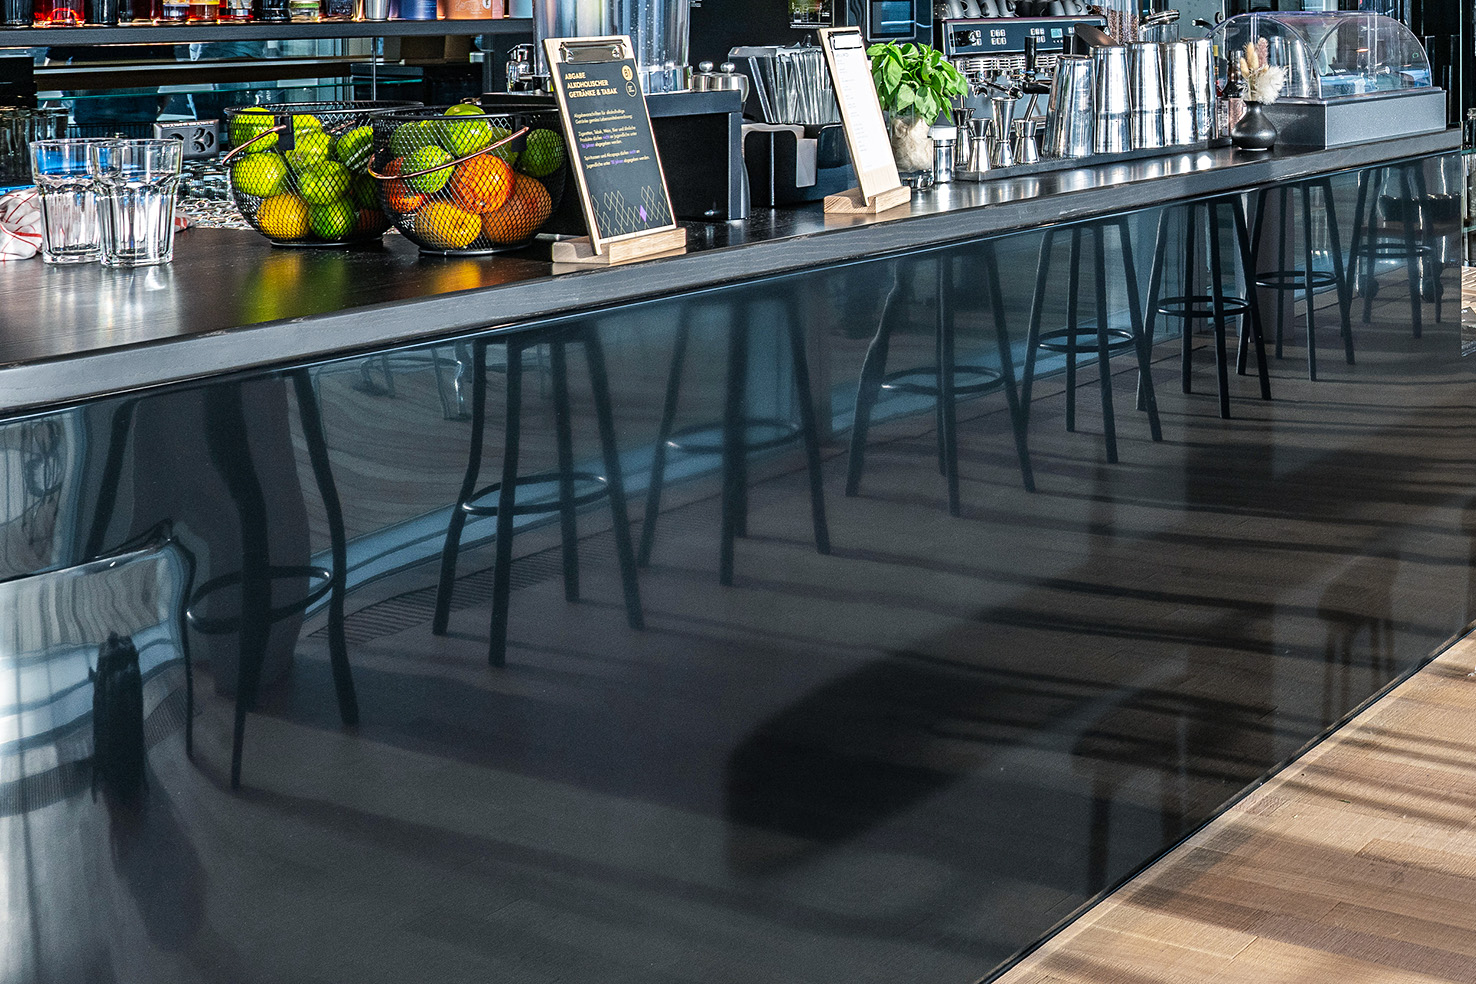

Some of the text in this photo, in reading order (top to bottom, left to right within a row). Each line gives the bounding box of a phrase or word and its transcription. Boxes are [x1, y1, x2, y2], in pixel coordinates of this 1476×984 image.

[565, 72, 586, 80] ABGABE
[567, 80, 609, 89] ALKOHOLISCHER
[569, 89, 596, 98] GETRÄNKE
